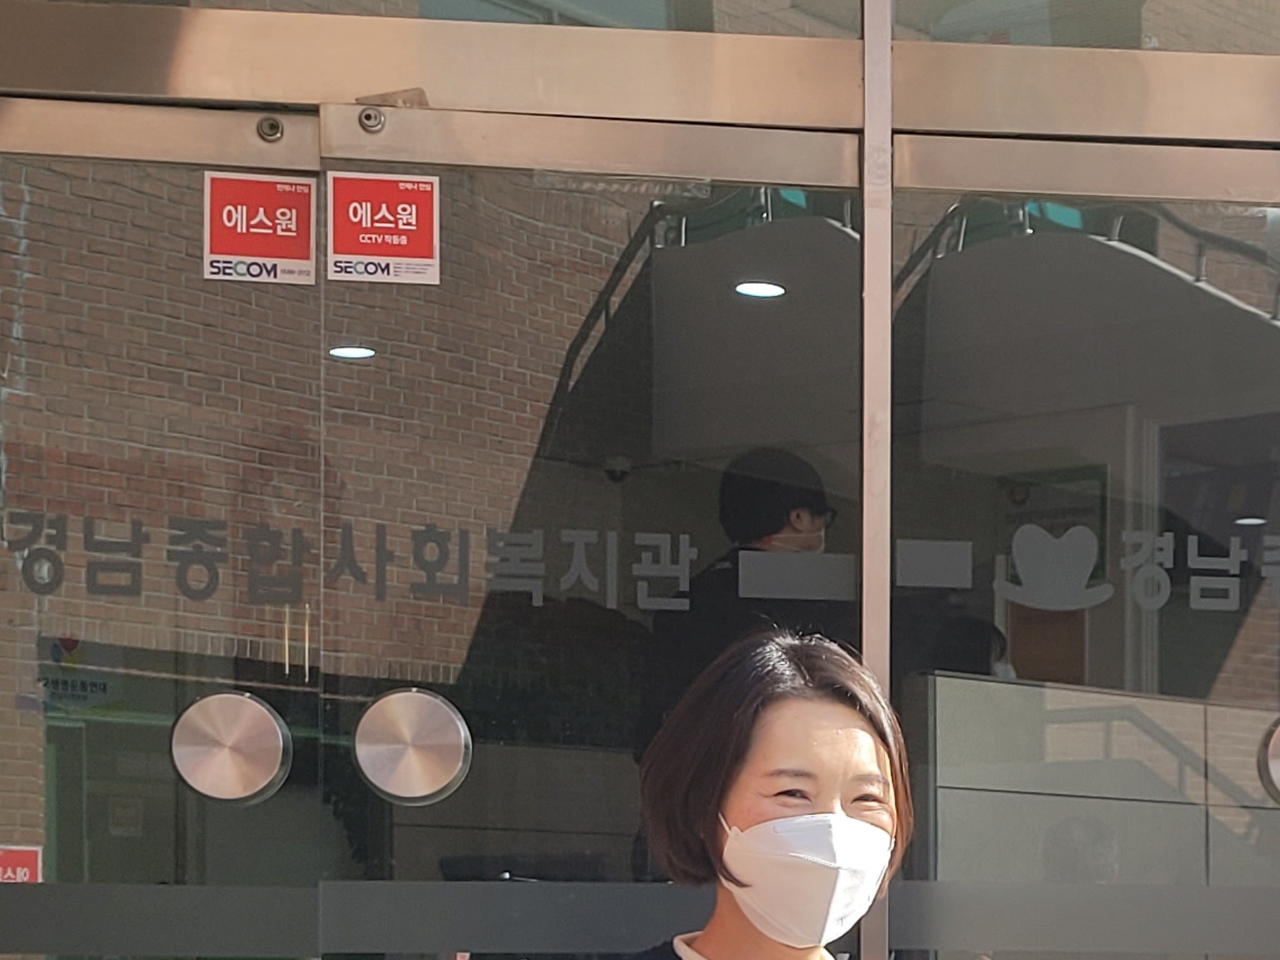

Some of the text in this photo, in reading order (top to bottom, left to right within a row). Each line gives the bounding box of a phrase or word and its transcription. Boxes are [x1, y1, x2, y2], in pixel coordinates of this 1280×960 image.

[222, 204, 297, 236] 에스원
[348, 202, 417, 230] 에스원
[359, 234, 383, 244] CCTV
[209, 260, 278, 279] SECOM
[333, 260, 390, 276] SECOM
[4, 511, 699, 611] 경남종합사회복지관
